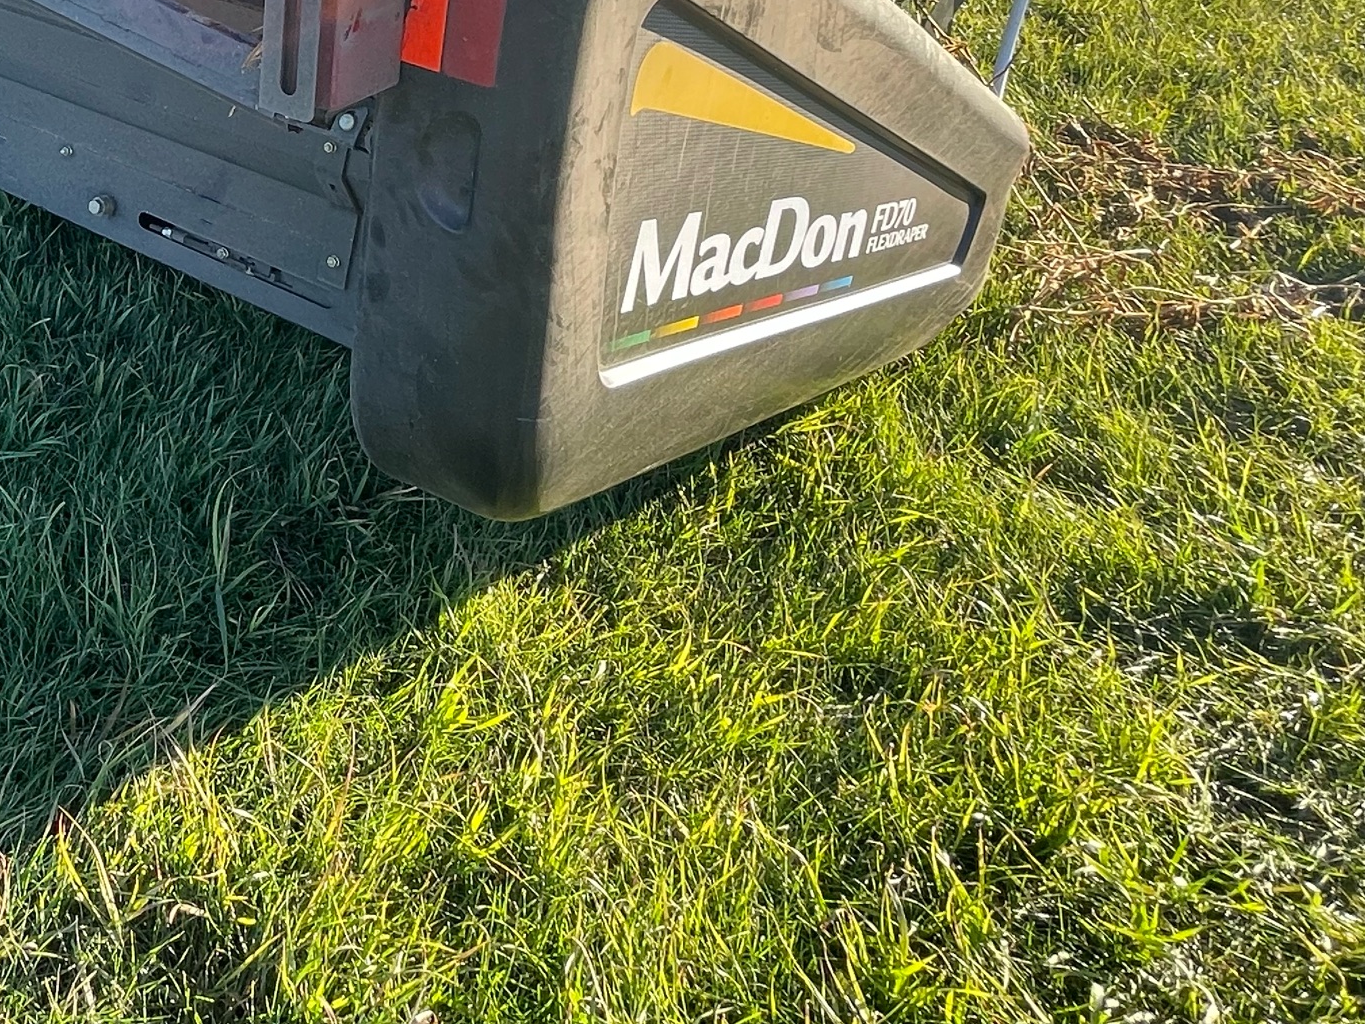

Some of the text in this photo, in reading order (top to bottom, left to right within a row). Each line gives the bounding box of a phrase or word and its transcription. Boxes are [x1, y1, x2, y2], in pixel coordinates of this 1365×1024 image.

[620, 196, 917, 313] MacDon FD70
[865, 223, 929, 254] FLEXDRAPER
